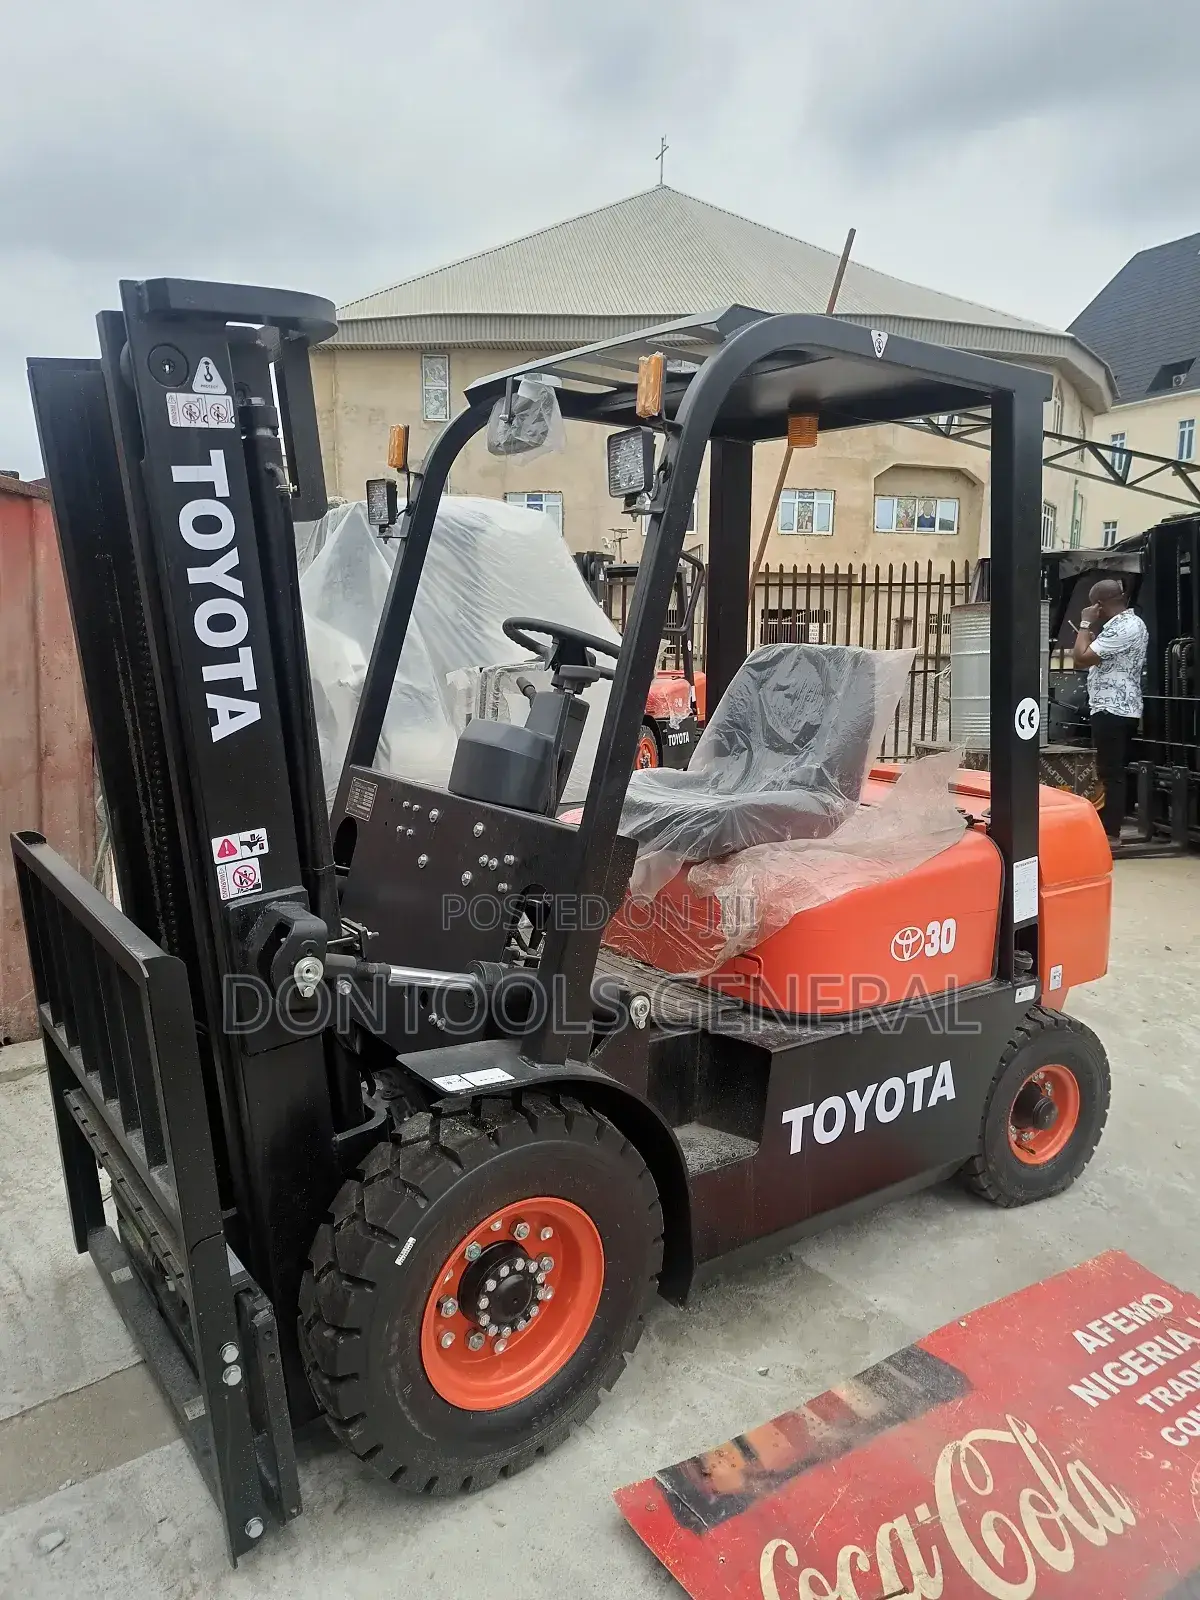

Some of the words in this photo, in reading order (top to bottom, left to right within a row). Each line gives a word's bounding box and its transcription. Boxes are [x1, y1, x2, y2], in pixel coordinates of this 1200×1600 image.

[170, 449, 262, 743] TOYOTA
[667, 731, 690, 747] TOYOTA
[1018, 708, 1035, 730] CE
[924, 918, 957, 957] 30
[781, 1060, 956, 1155] TOYOTA
[1072, 1293, 1174, 1355] AFEMO
[1067, 1328, 1200, 1408] NIGERIA
